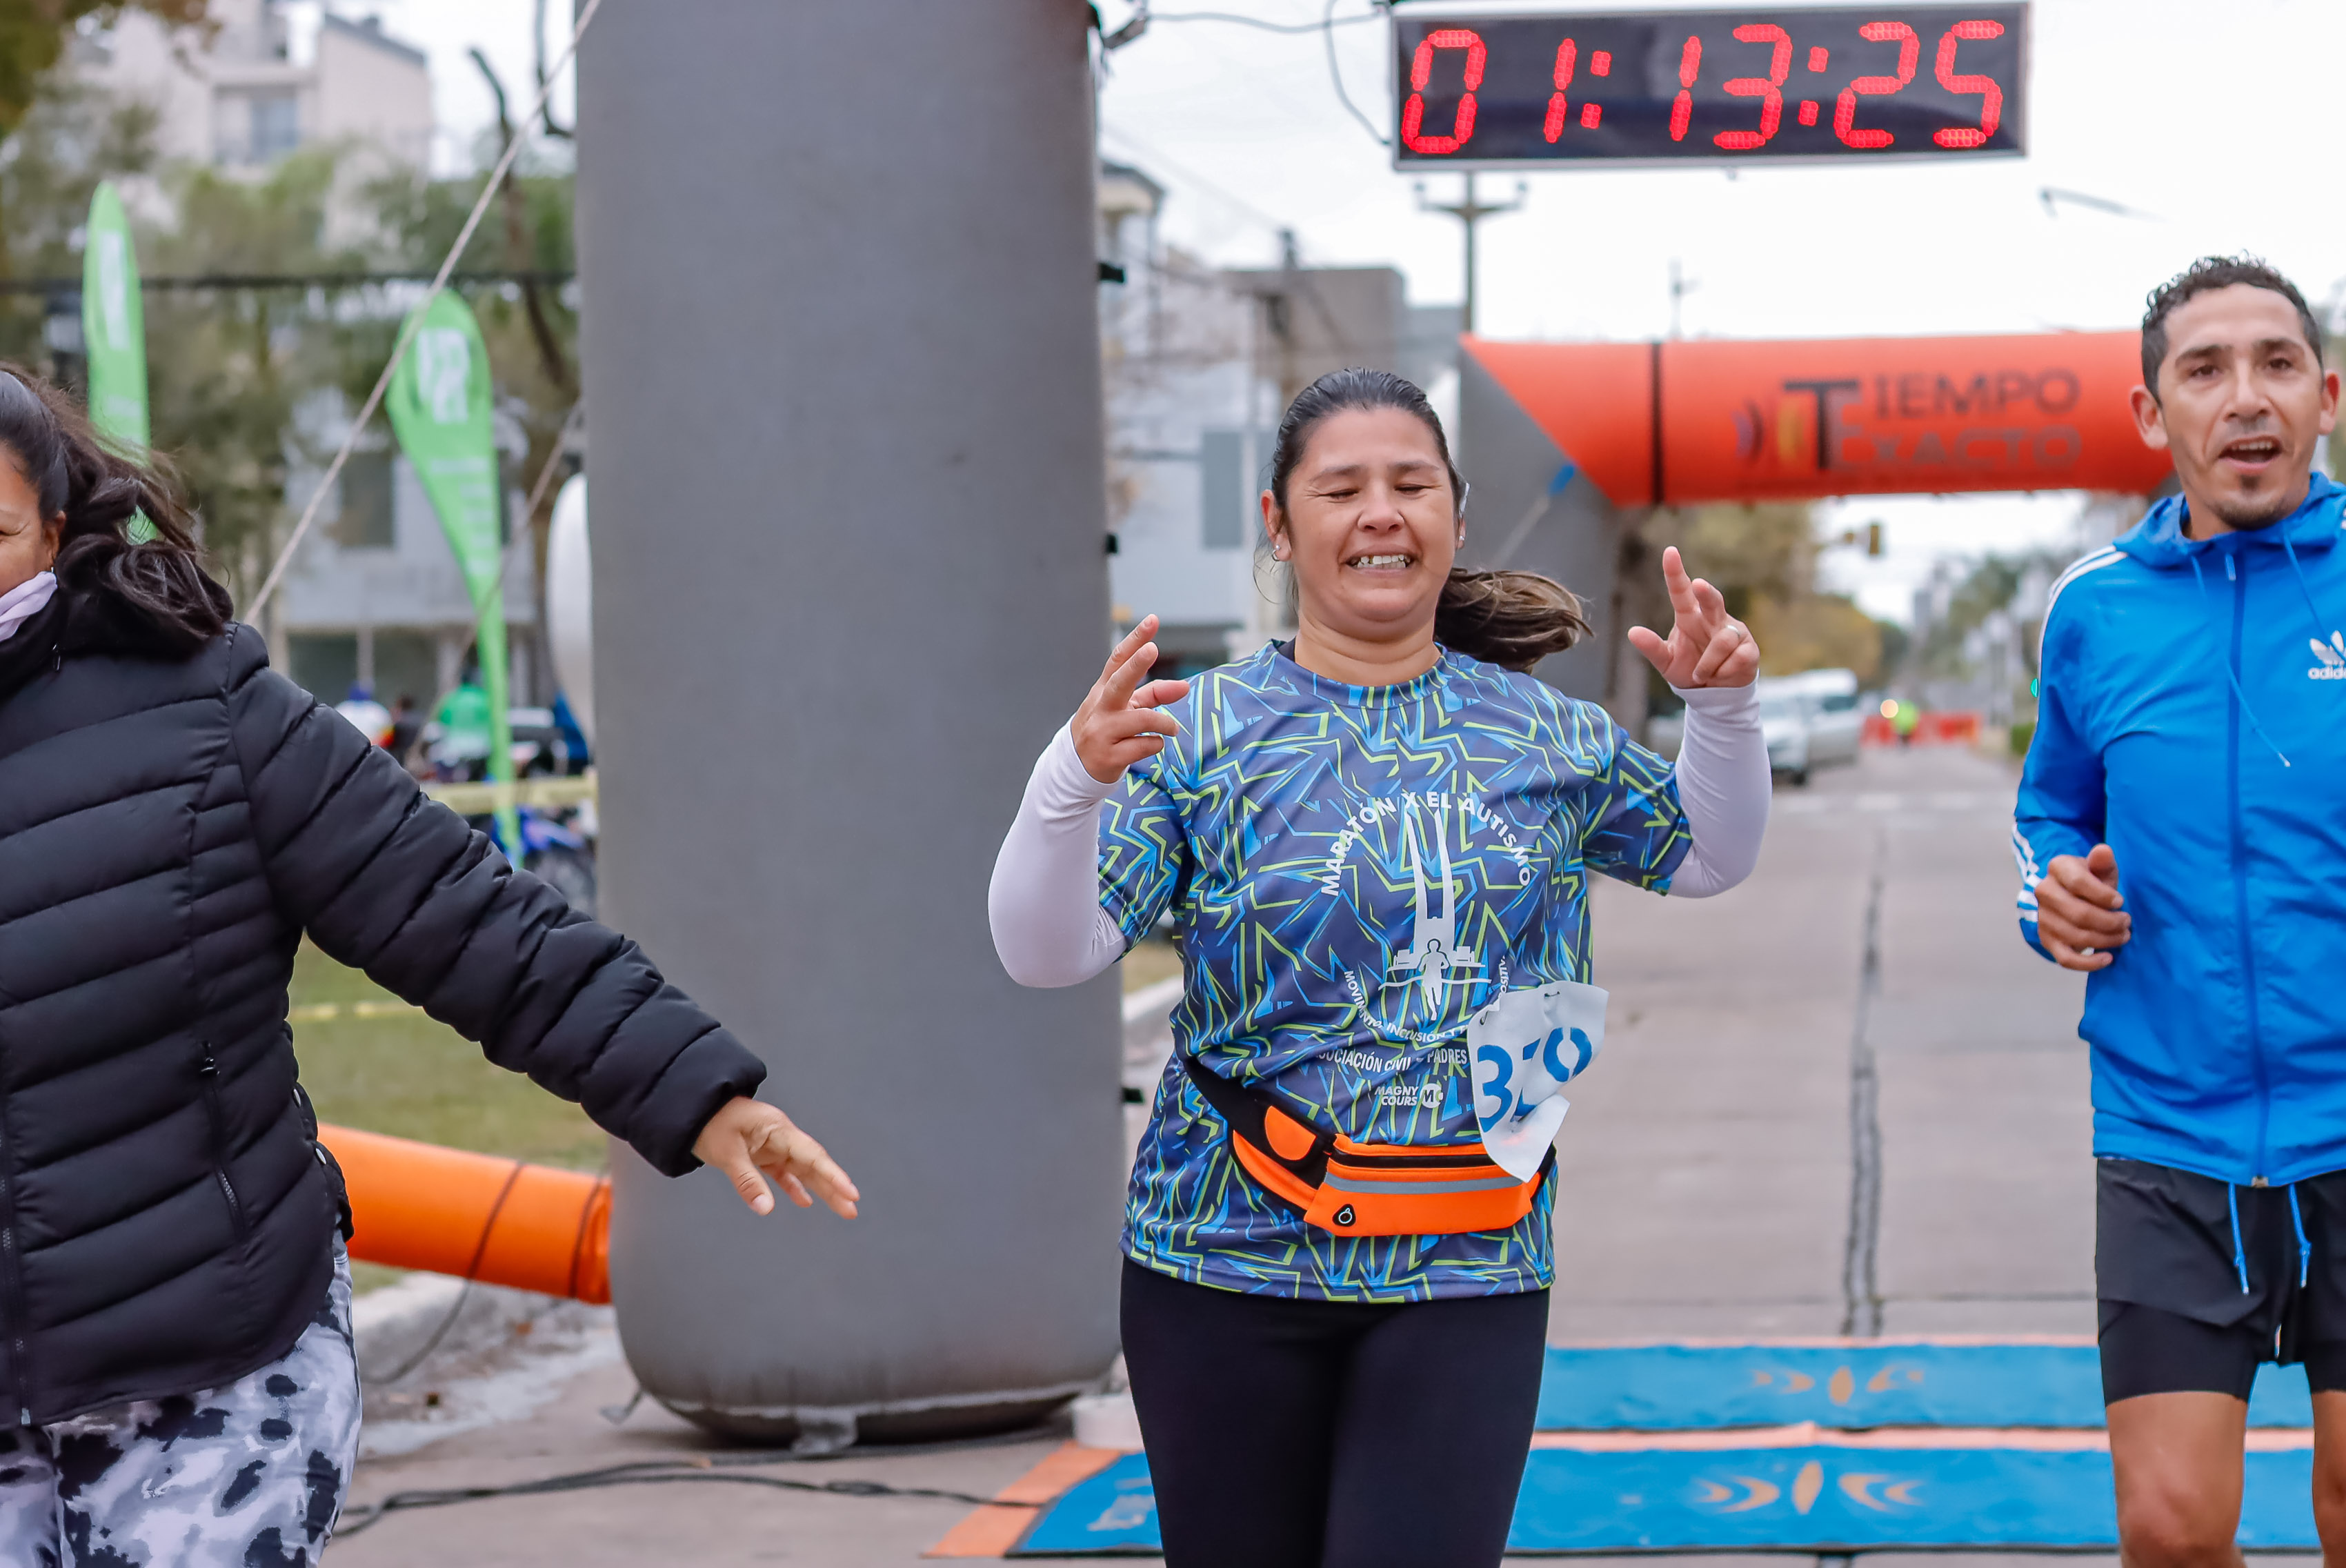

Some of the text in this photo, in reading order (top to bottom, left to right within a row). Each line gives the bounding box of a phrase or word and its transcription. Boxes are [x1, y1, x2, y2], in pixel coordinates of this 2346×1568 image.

[1401, 21, 2005, 154] 01:13:25
[1782, 367, 2082, 473] TIEMPO
[2307, 666, 2346, 680] adid
[1321, 791, 1531, 896] MARATÓN X EL AUTISMO
[1427, 1048, 1468, 1064] PADRES
[1374, 1085, 1420, 1096] MAGNY
[1381, 1095, 1418, 1106] COURS
